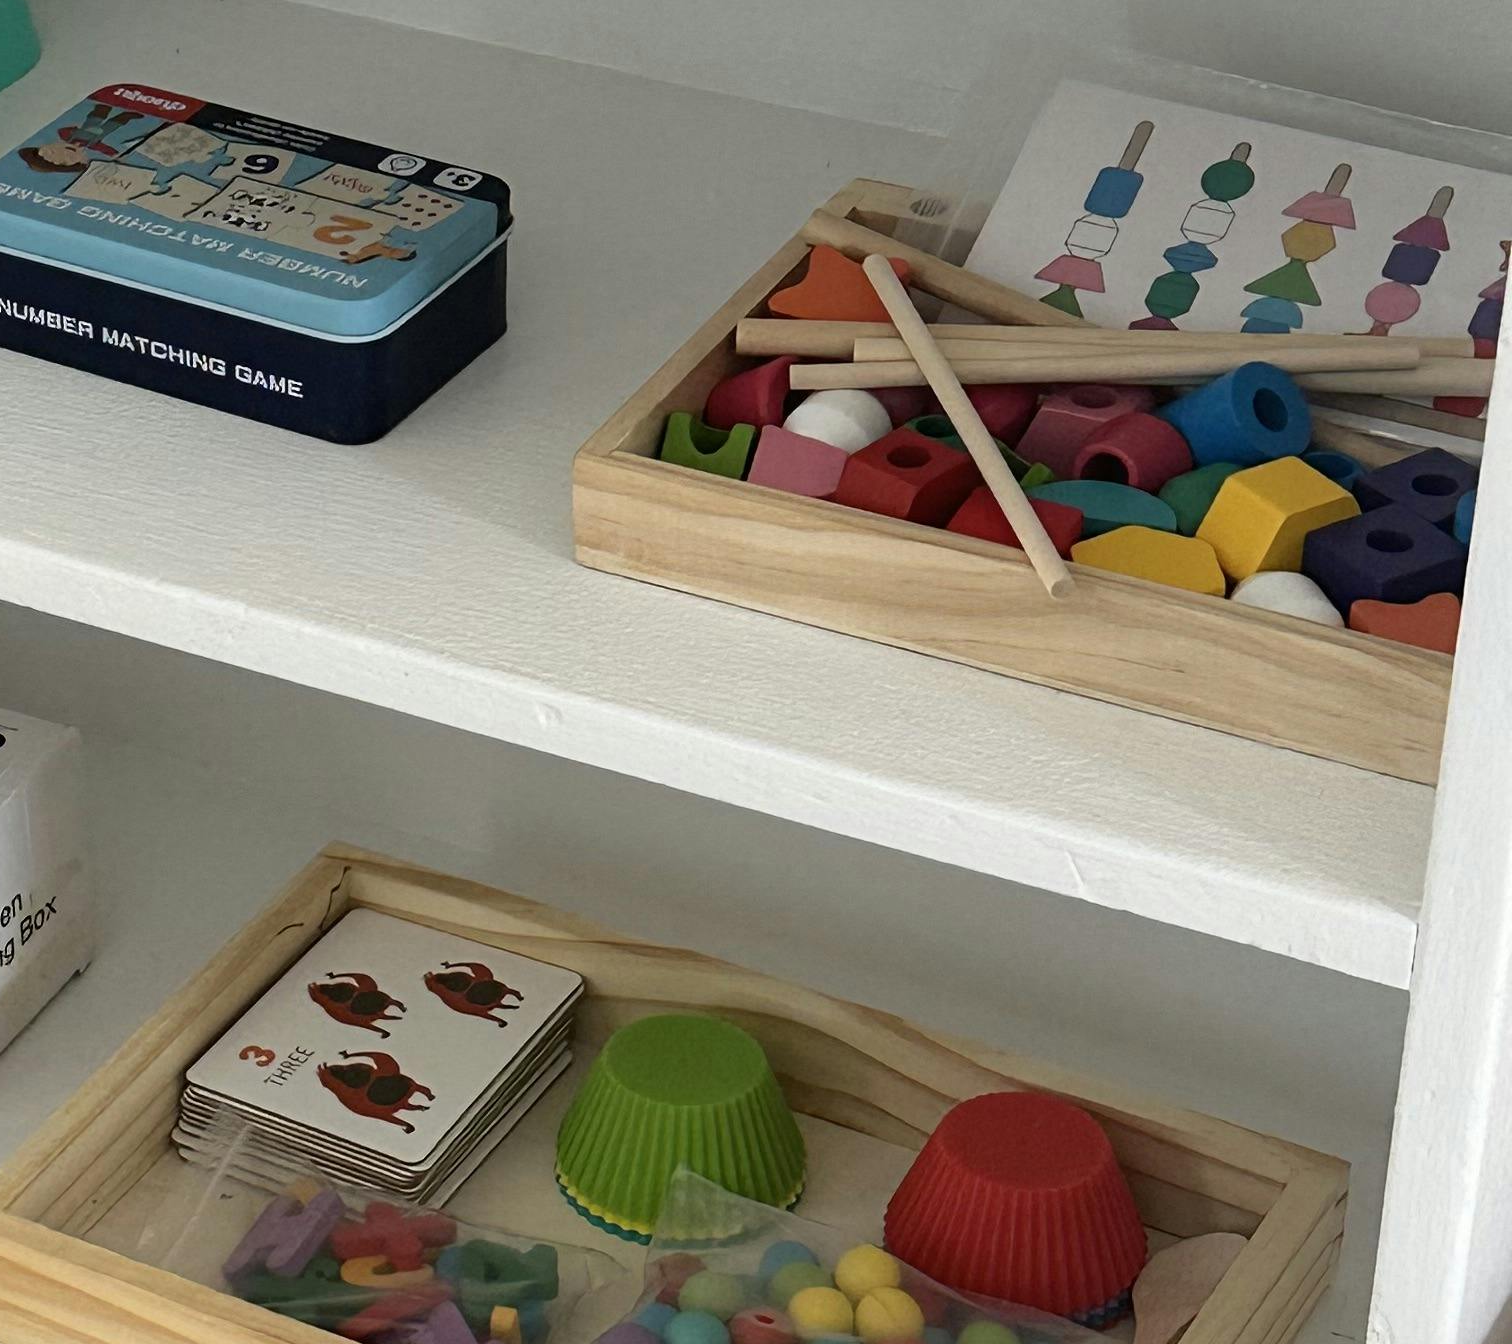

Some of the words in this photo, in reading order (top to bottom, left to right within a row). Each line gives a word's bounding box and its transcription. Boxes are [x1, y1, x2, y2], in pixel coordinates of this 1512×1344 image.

[76, 206, 235, 254] MATCHING
[313, 214, 374, 245] 2
[239, 245, 369, 289] NUMBER
[101, 326, 227, 377] MATCHING
[234, 364, 305, 399] GAME
[20, 896, 57, 946] Box
[238, 1045, 277, 1068] 3
[264, 1046, 316, 1089] THREE
